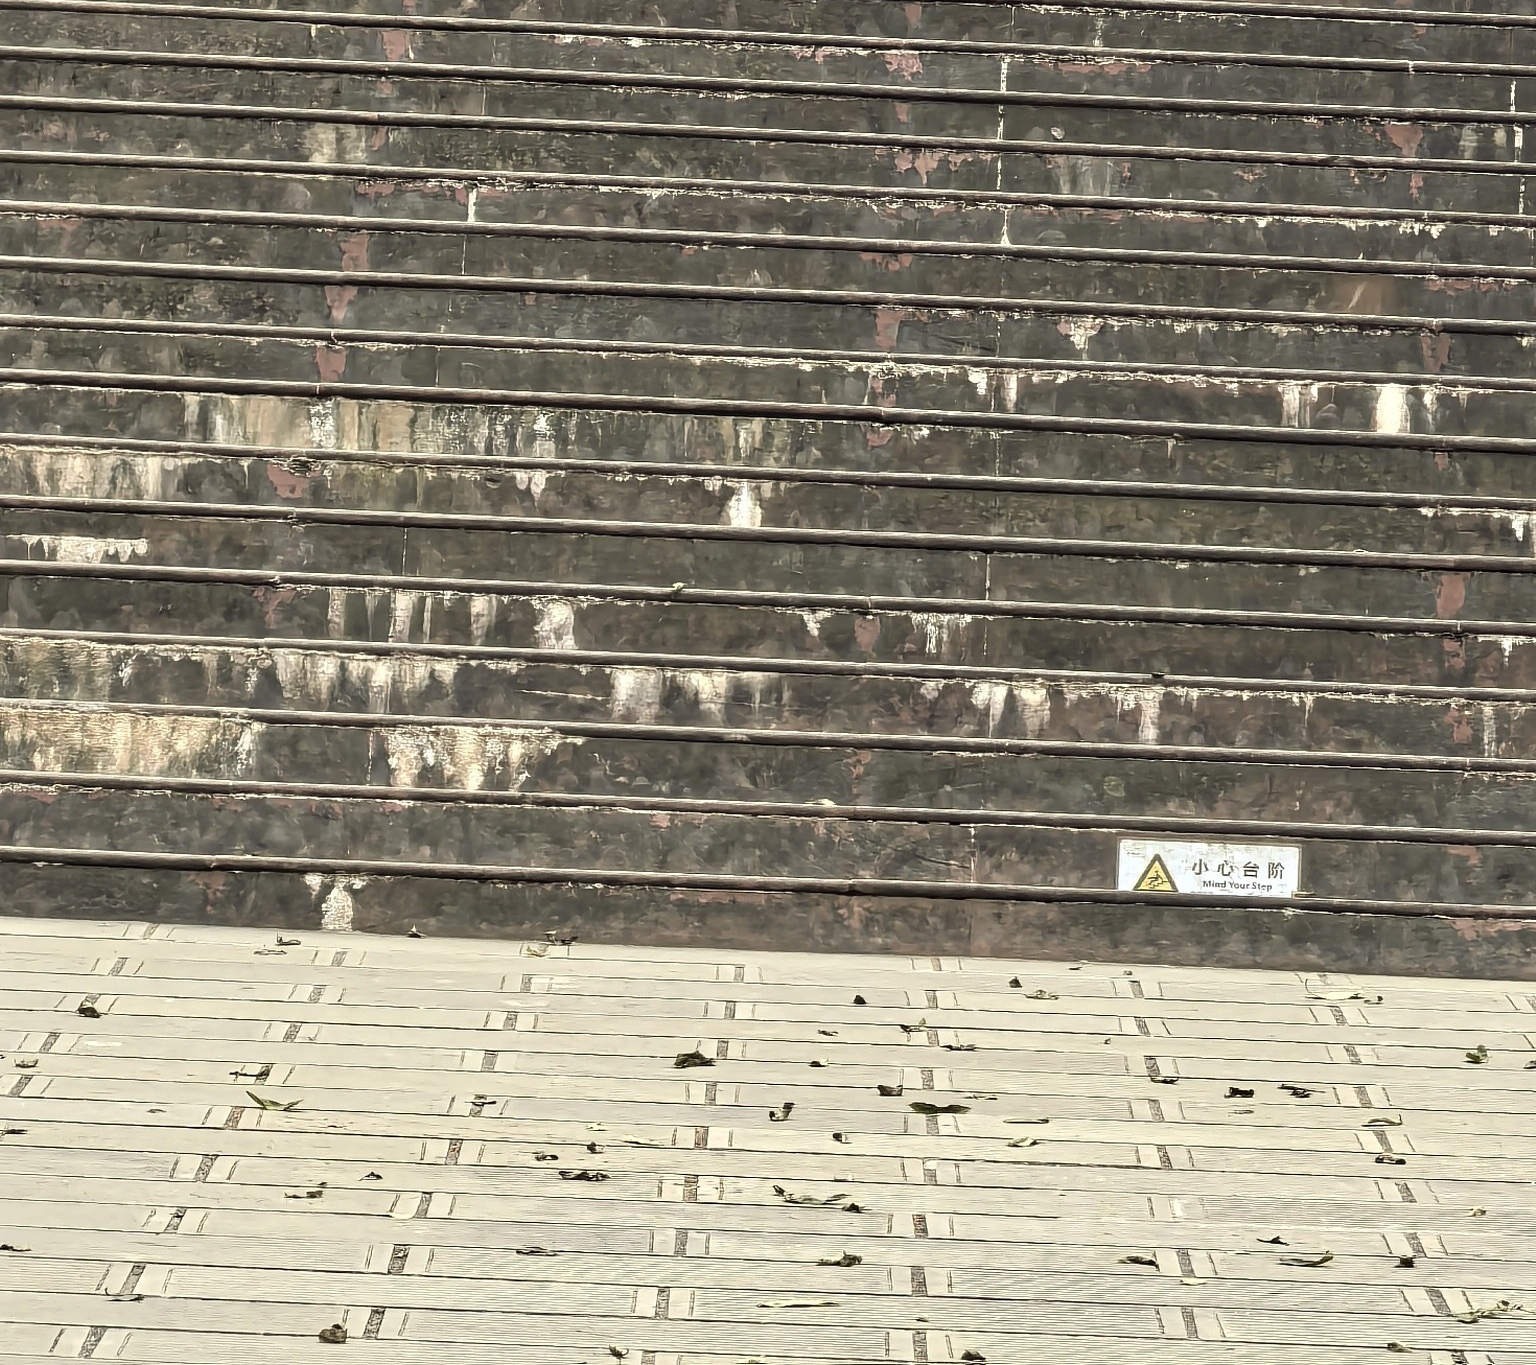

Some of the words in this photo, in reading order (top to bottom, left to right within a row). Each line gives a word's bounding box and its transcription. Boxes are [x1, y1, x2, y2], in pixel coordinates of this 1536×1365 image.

[1191, 858, 1285, 879] 小心台阶
[1203, 880, 1227, 889] Mind
[1229, 881, 1251, 890] Your
[1252, 881, 1273, 892] Step
